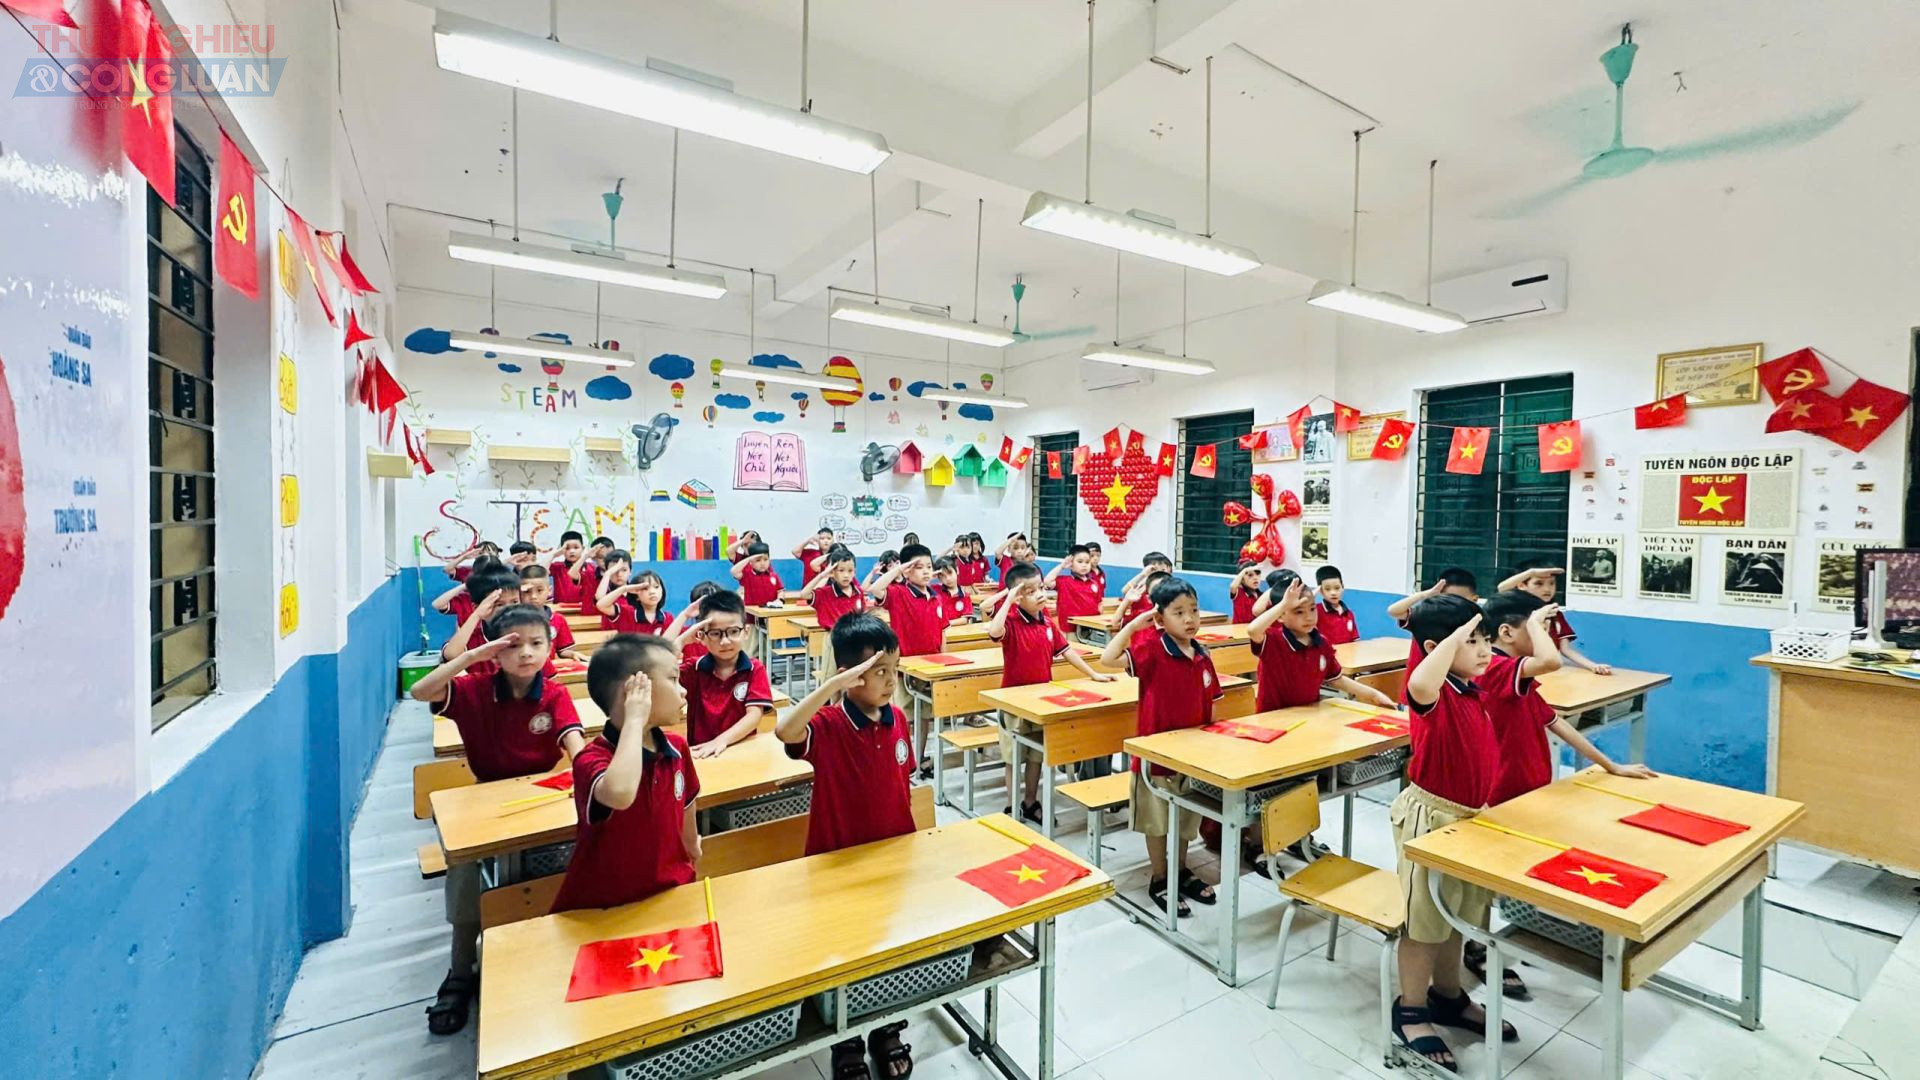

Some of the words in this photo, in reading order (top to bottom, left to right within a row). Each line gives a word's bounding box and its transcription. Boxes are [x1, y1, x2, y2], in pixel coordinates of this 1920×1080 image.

[81, 361, 92, 387] SA
[501, 383, 578, 413] STEAM
[1645, 457, 1684, 470] TUYÊN
[1688, 456, 1726, 469] NGÔN
[1731, 455, 1760, 470] ĐỘC
[1764, 453, 1793, 469] LẬP
[1692, 475, 1713, 485] ĐỘC
[1715, 475, 1737, 485] LẬP
[87, 509, 98, 532] SA
[423, 500, 636, 560] STEAM
[1726, 539, 1753, 550] BẠN
[1758, 538, 1787, 550] DÂN
